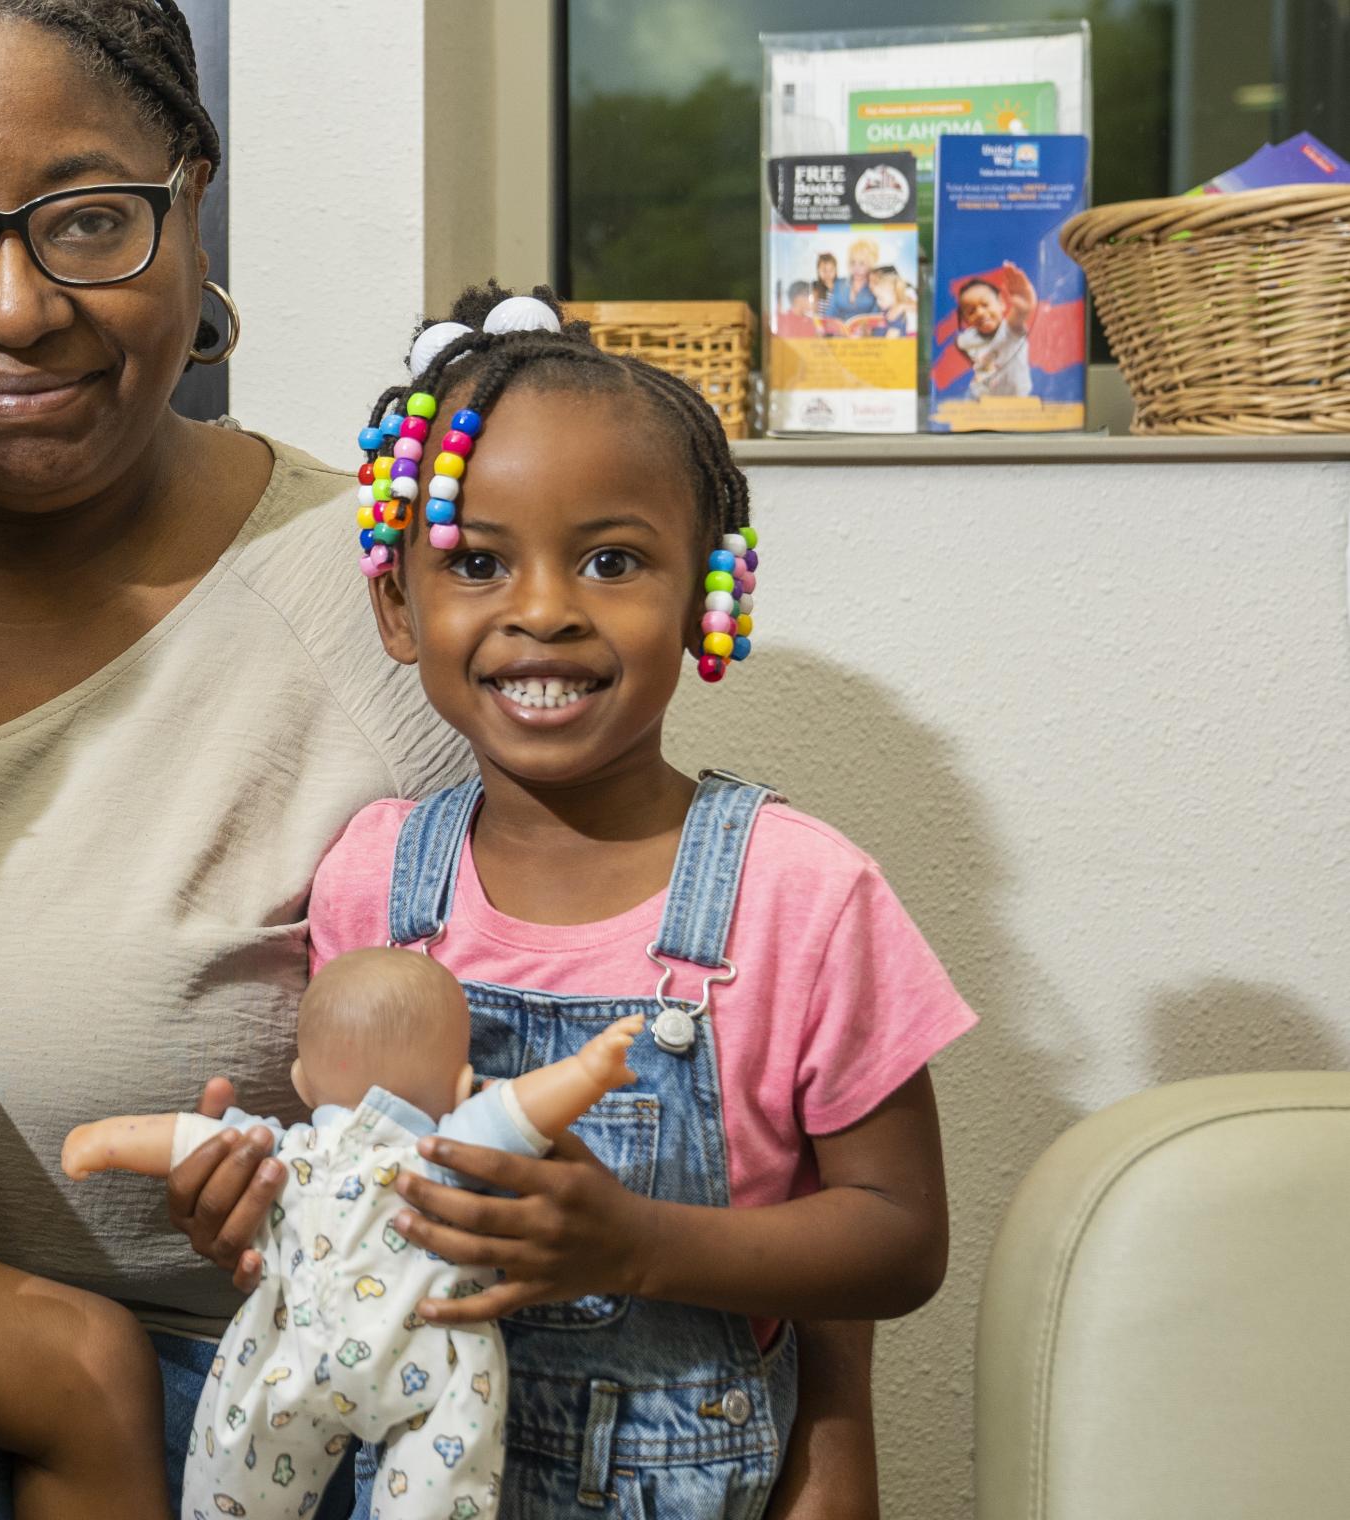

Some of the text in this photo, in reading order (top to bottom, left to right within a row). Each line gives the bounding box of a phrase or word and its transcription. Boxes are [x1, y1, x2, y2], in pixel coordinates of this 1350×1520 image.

[866, 119, 985, 142] OKLAHOMA
[981, 144, 1013, 157] United
[993, 156, 1013, 168] Way
[794, 165, 846, 182] FREE
[794, 182, 845, 196] Books
